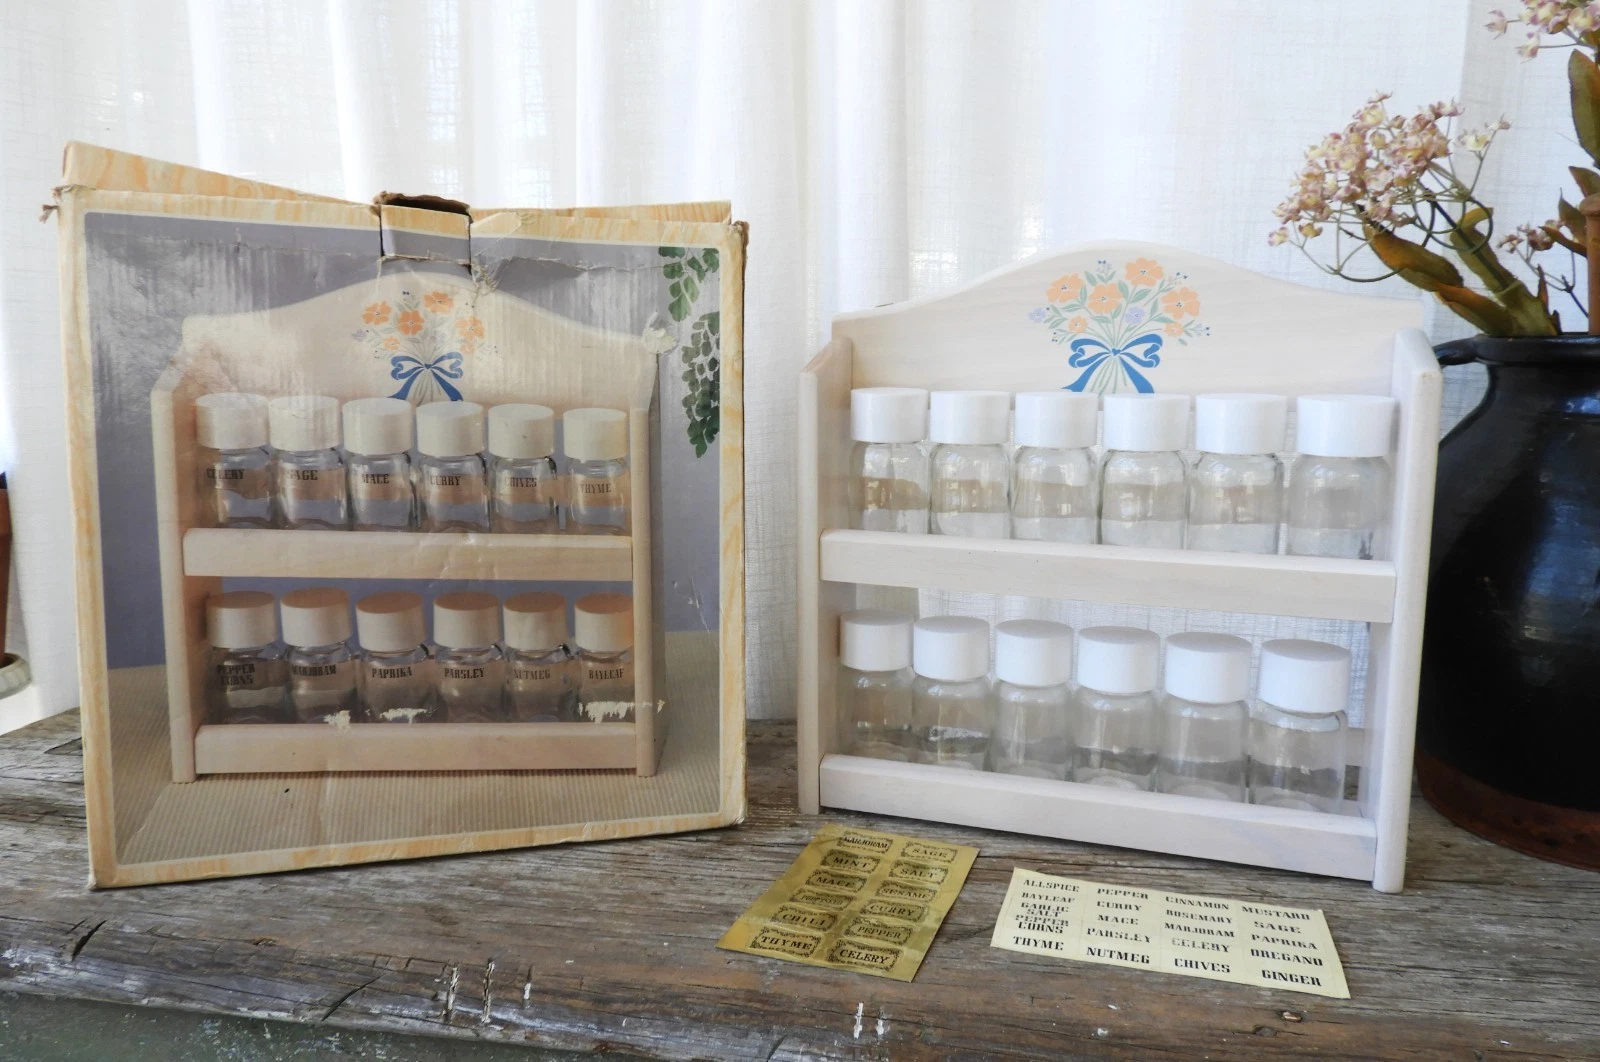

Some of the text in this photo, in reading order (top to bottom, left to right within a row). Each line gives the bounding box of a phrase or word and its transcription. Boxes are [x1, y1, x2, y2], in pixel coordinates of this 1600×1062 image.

[372, 667, 412, 679] PAPRIKA
[444, 668, 484, 679] PARSLEY
[589, 668, 624, 680] BAYLEAF
[912, 848, 947, 858] SAGE
[834, 857, 870, 868] MINT
[900, 868, 937, 878] SALT
[816, 877, 855, 887] MACE
[1023, 879, 1080, 892] ALLSPICE
[881, 888, 930, 898] SESAME
[1022, 892, 1075, 903] BAYLEAF
[1097, 888, 1149, 900] PEPPER
[1021, 902, 1069, 912] GARLIC
[1097, 900, 1142, 912] CURRY
[1166, 896, 1229, 910] CINNAMON
[870, 905, 914, 916] CURRY
[1026, 908, 1061, 918] SALT
[1166, 909, 1232, 924] ROSEMARY
[1242, 906, 1310, 920] MUSTARD
[783, 914, 826, 926] CHILI
[1016, 914, 1069, 926] PEPPER
[1098, 914, 1139, 926] MACE
[858, 926, 901, 938] PEPPER
[1018, 921, 1064, 934] CORNS
[1164, 922, 1235, 938] MARJORAM
[1254, 920, 1301, 934] SAGE
[1086, 928, 1151, 943] PARSLEY
[762, 936, 812, 950] THYME
[1013, 936, 1064, 951] THYME
[1172, 938, 1230, 953] CELERY
[1252, 934, 1318, 950] PAPRIKA
[840, 949, 890, 964] CELERY
[1086, 947, 1150, 964] NUTMEG
[1251, 948, 1324, 967] OREGANO
[1174, 958, 1231, 974] CHIVES
[1262, 969, 1322, 987] GINGER
